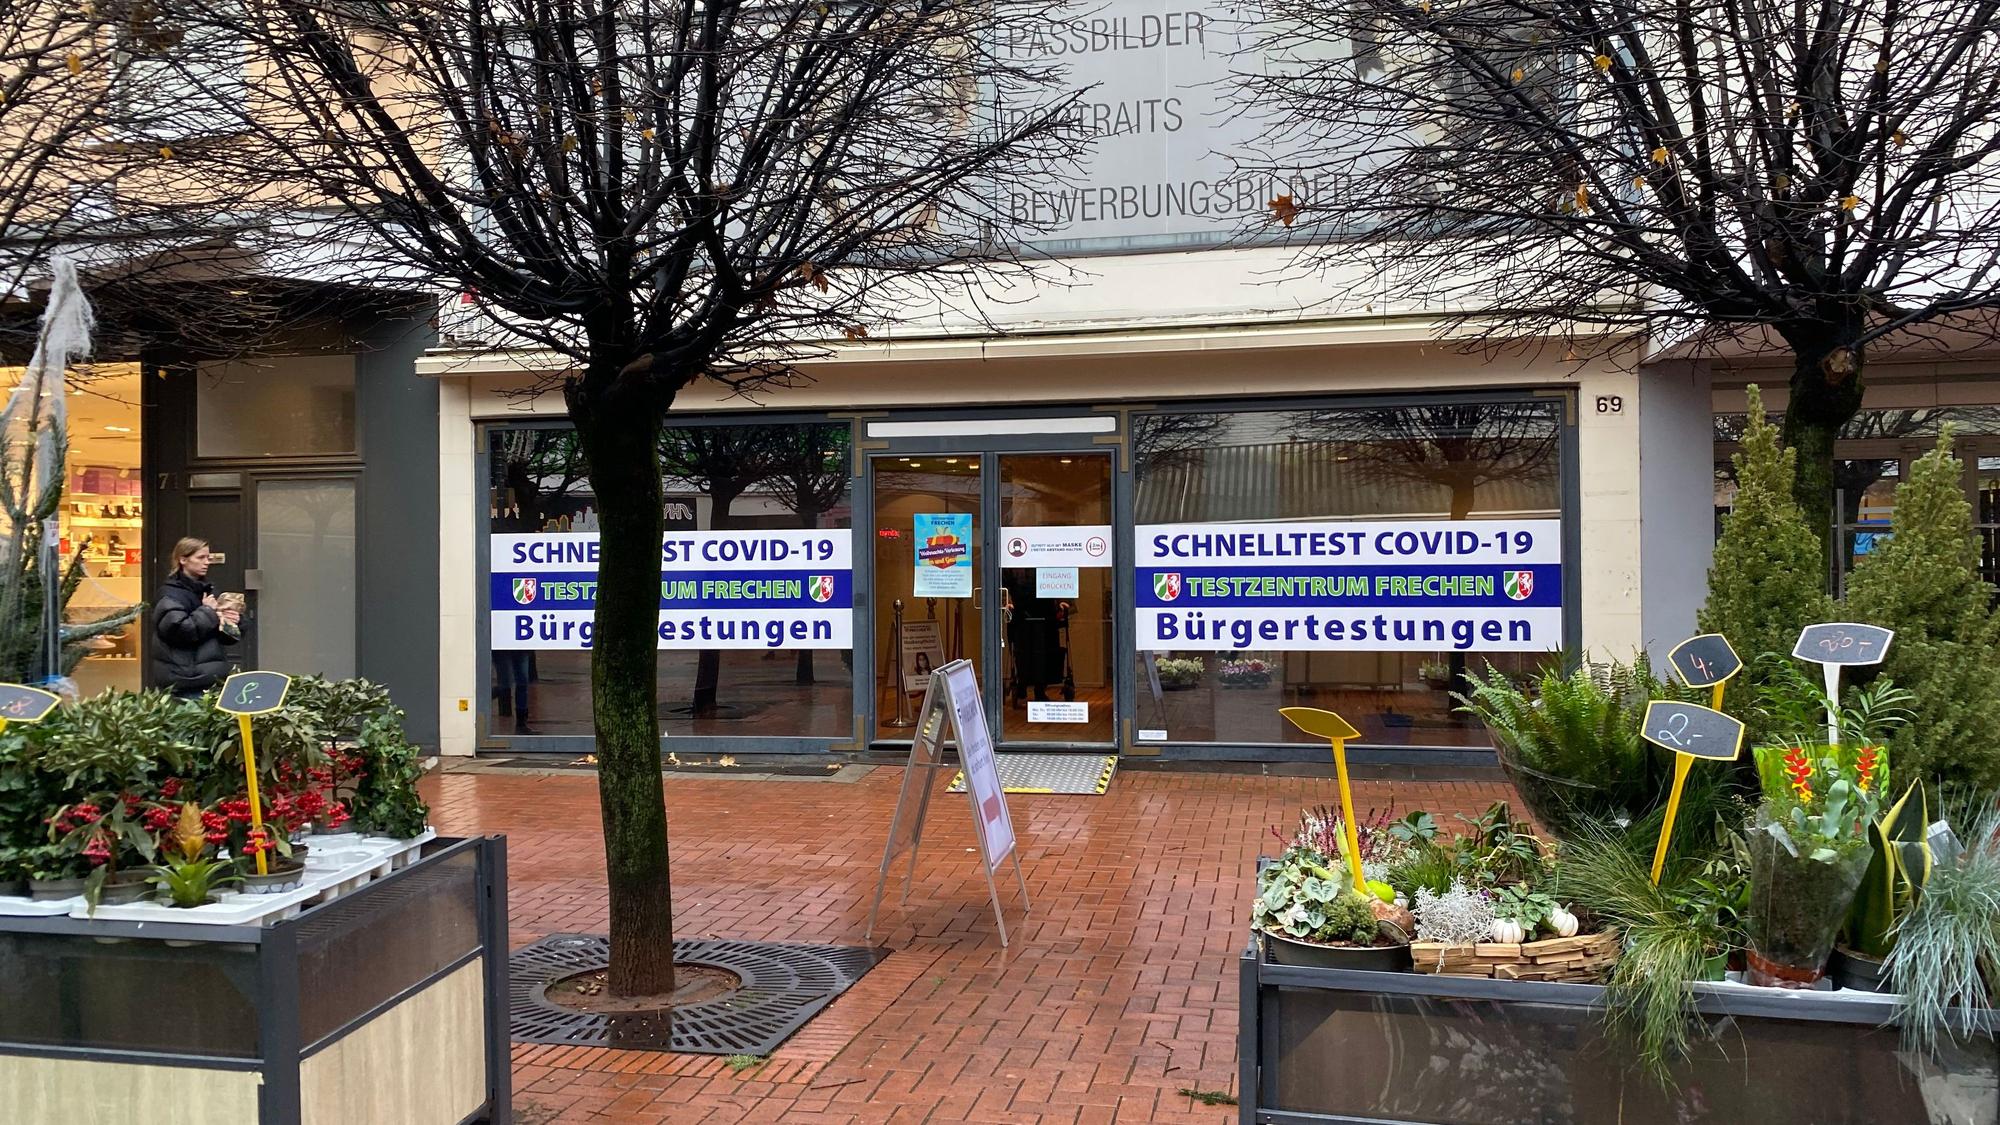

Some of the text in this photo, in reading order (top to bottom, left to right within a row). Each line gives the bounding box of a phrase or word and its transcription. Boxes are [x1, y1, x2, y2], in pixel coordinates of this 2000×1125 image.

[1009, 11, 1204, 58] PASSBILDER
[1597, 396, 1622, 413] 69
[513, 540, 834, 564] SCHNEST COVID-19
[1153, 531, 1533, 558] SCHNELLTEST COVID-19
[541, 580, 802, 600] TESTUM FRECHEN
[1186, 575, 1494, 597] TESTZENTRUM FRECHEN
[515, 614, 832, 648] Bürgestungen
[1157, 611, 1532, 649] Bürgertestungen
